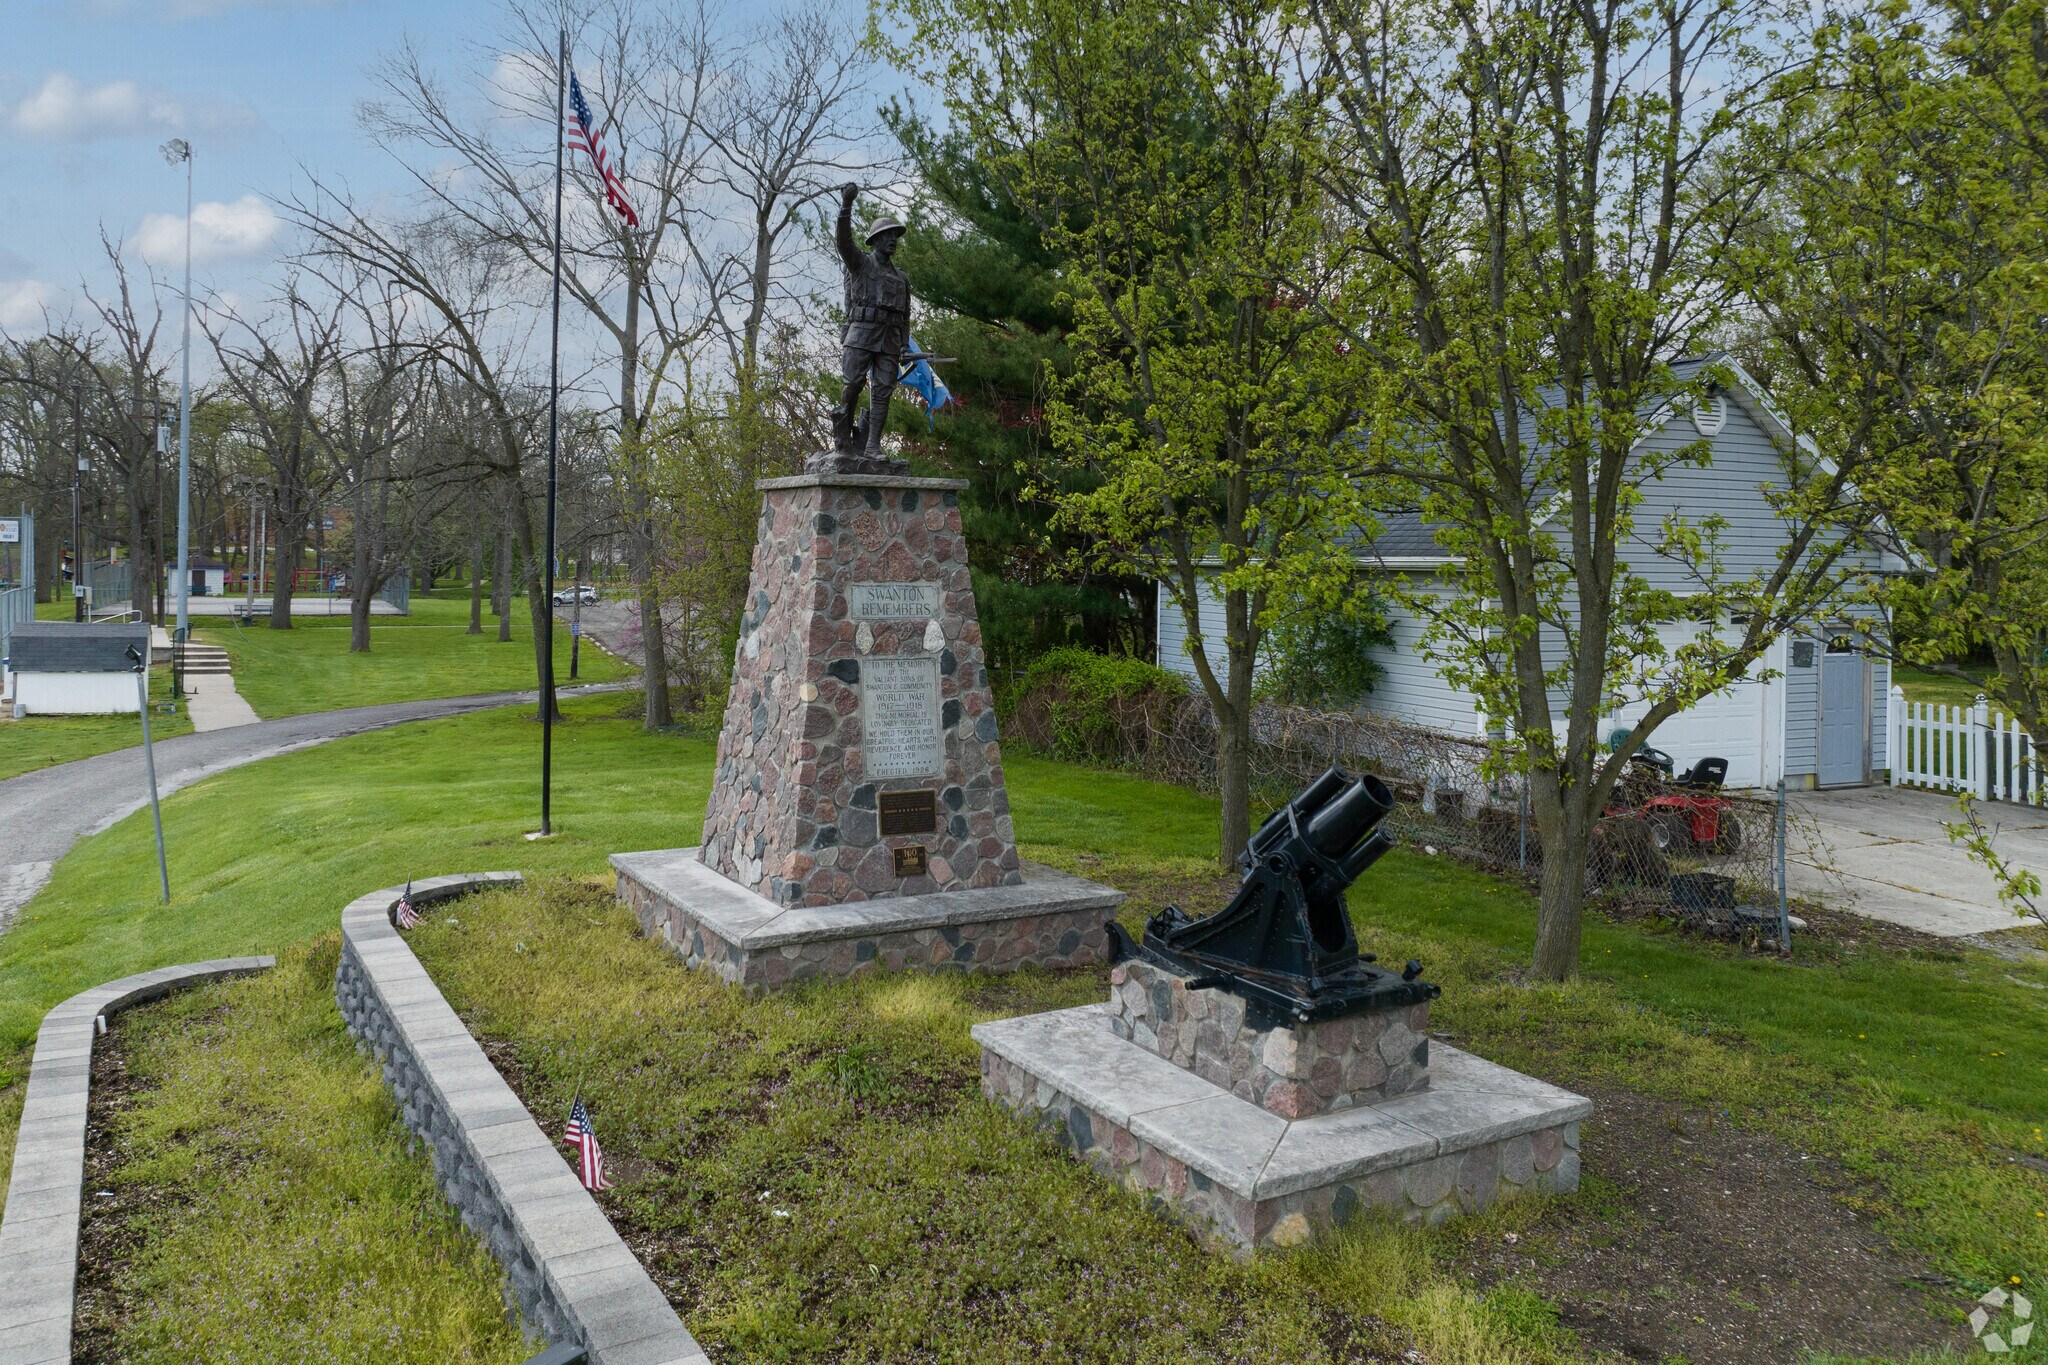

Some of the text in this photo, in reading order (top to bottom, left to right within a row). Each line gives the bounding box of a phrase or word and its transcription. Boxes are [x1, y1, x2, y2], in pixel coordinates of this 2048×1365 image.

[867, 588, 924, 601] SWANTON
[862, 603, 931, 616] REMEMBERS
[872, 661, 880, 669] TO
[898, 660, 926, 668] MEMORY
[876, 692, 924, 702] WORLD WAR
[870, 718, 932, 728] LOVINGLY DEDICATED
[866, 745, 900, 754] REVERENCE
[890, 752, 916, 760] FOREVER
[876, 768, 907, 776] ERECTED
